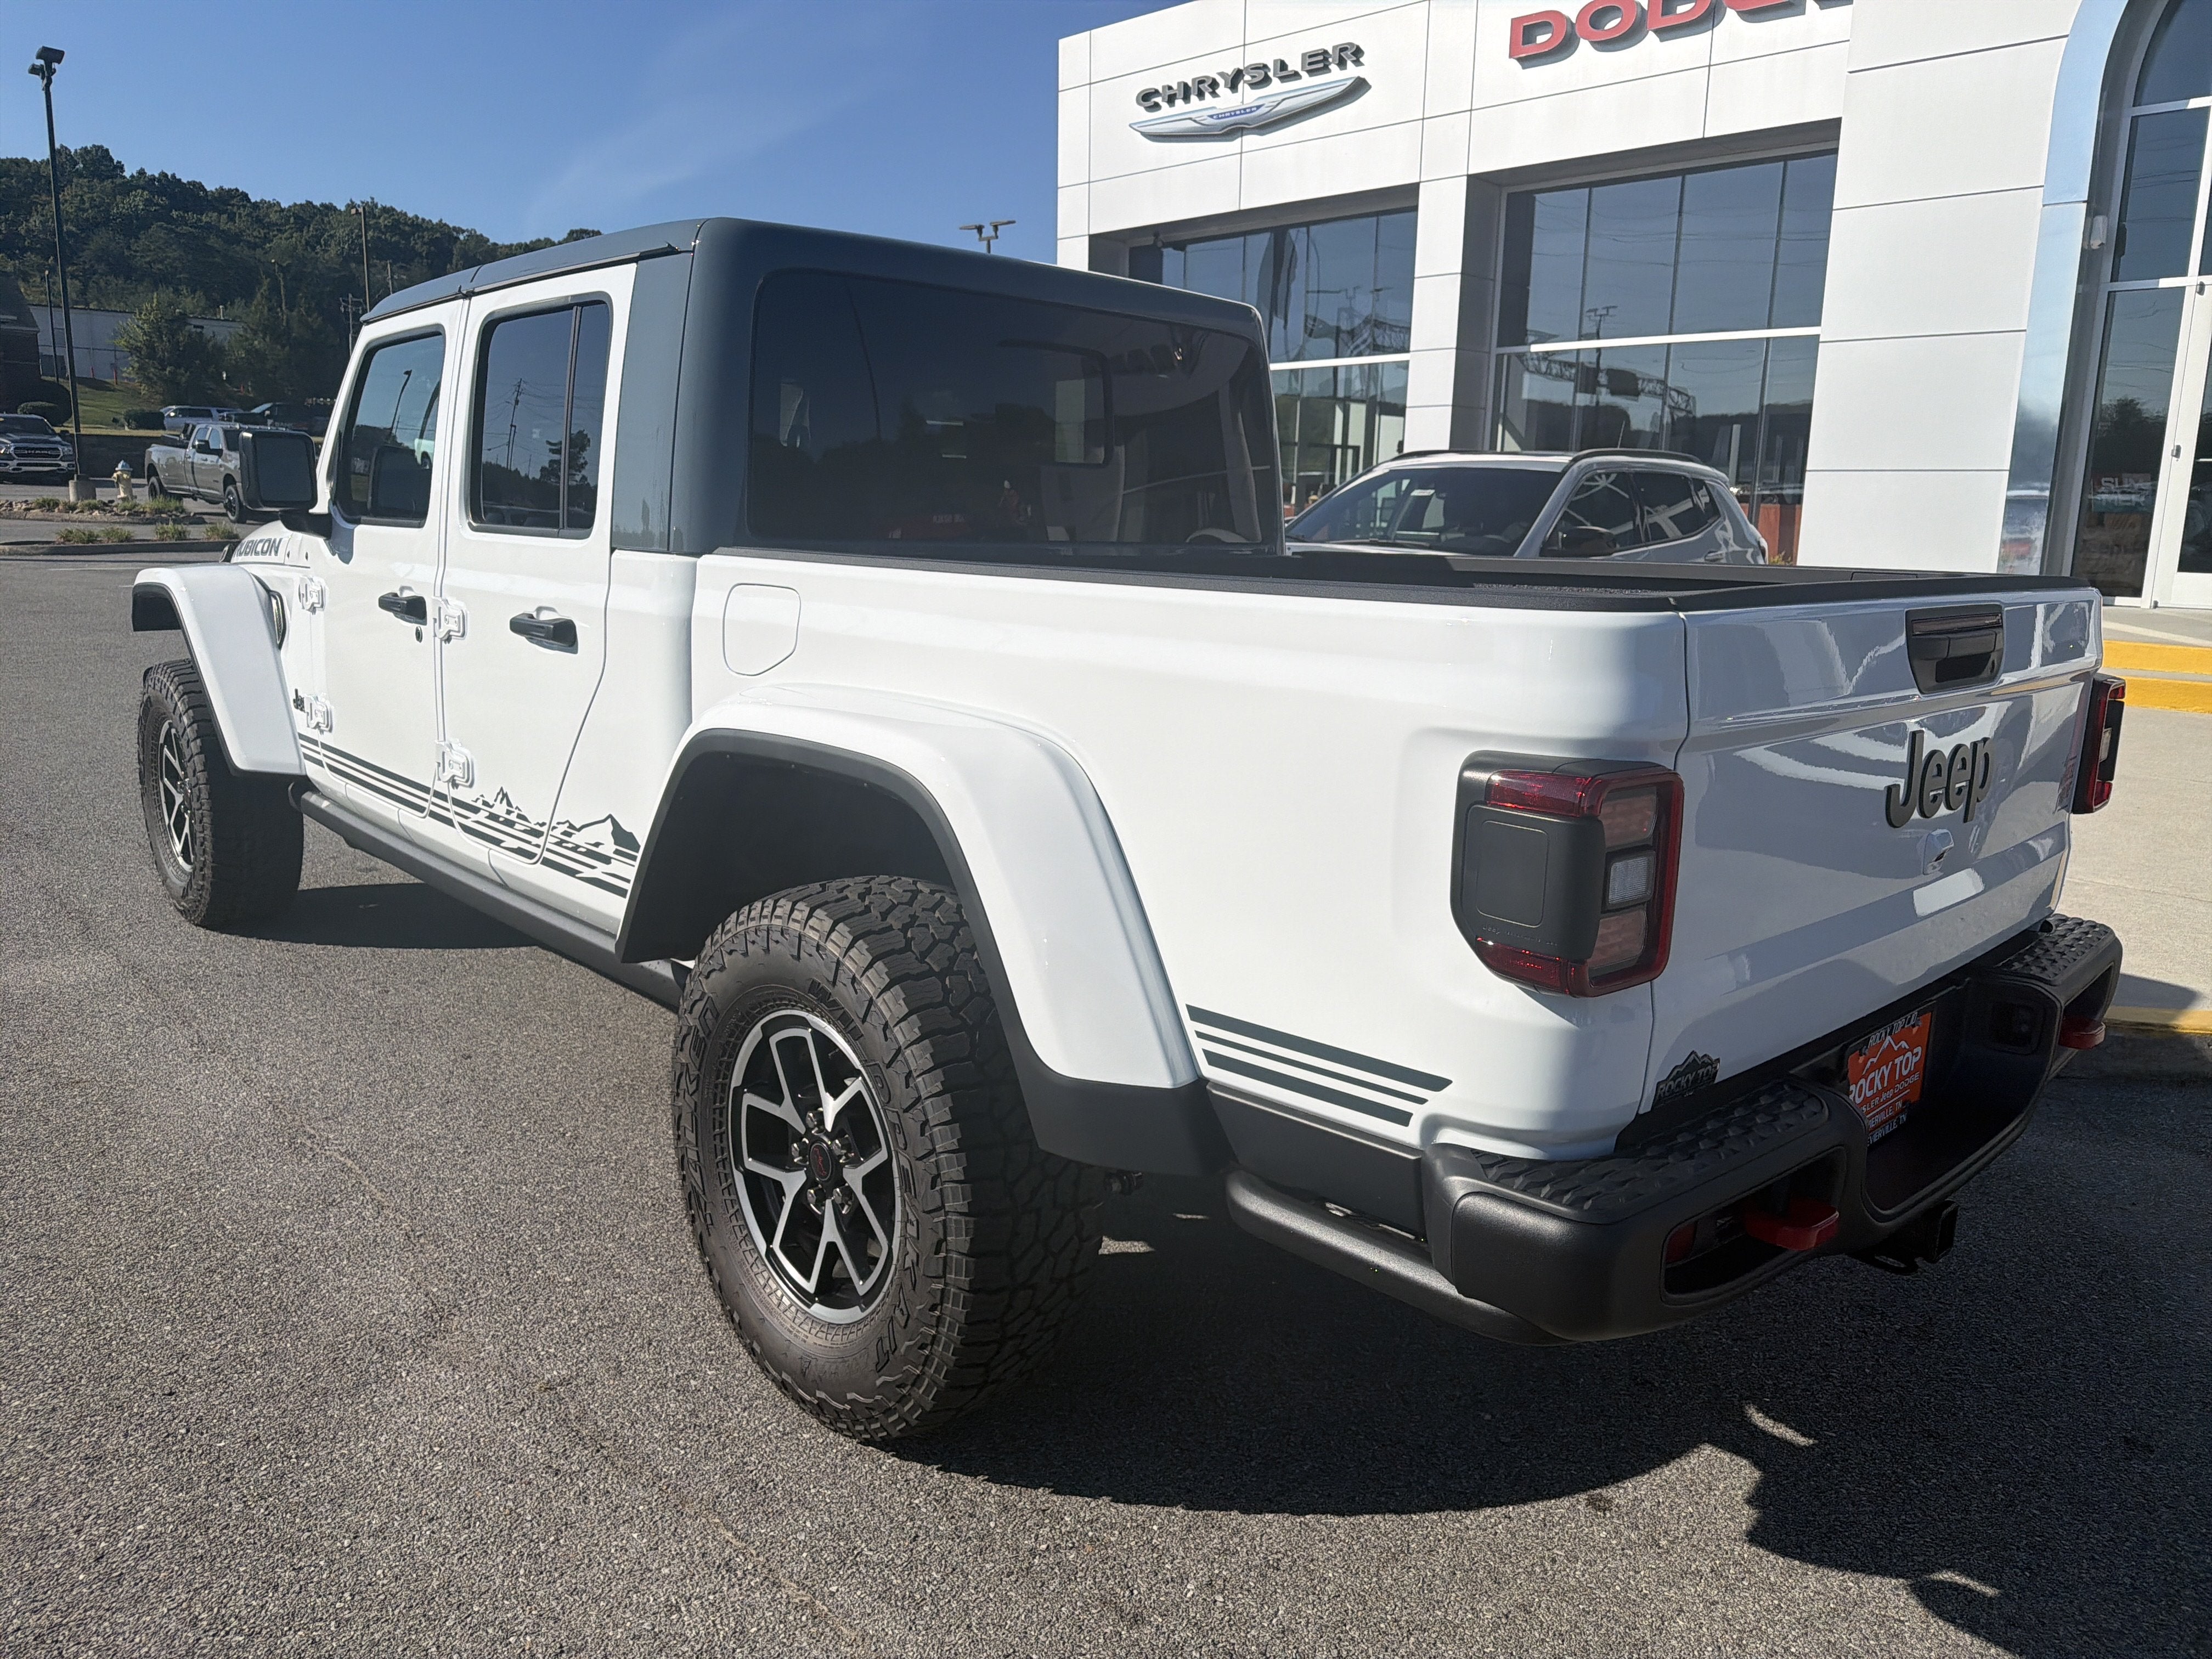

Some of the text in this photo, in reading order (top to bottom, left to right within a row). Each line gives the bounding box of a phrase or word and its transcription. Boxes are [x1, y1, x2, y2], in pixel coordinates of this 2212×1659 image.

[1509, 0, 1853, 69] DOD
[1136, 42, 1365, 112] CHRYSLER
[1212, 106, 1257, 119] CHRYSLER
[1884, 729, 1992, 828] Jeep
[1867, 1025, 1892, 1048] ROCKY
[1892, 1019, 1905, 1036] TOP
[1657, 1071, 1696, 1098] ROCKY
[1849, 1046, 1922, 1104] ROCKY TOP
[1880, 1088, 1894, 1103] Jeep
[1894, 1071, 1920, 1093] DODGE
[1895, 1099, 1903, 1111] TN
